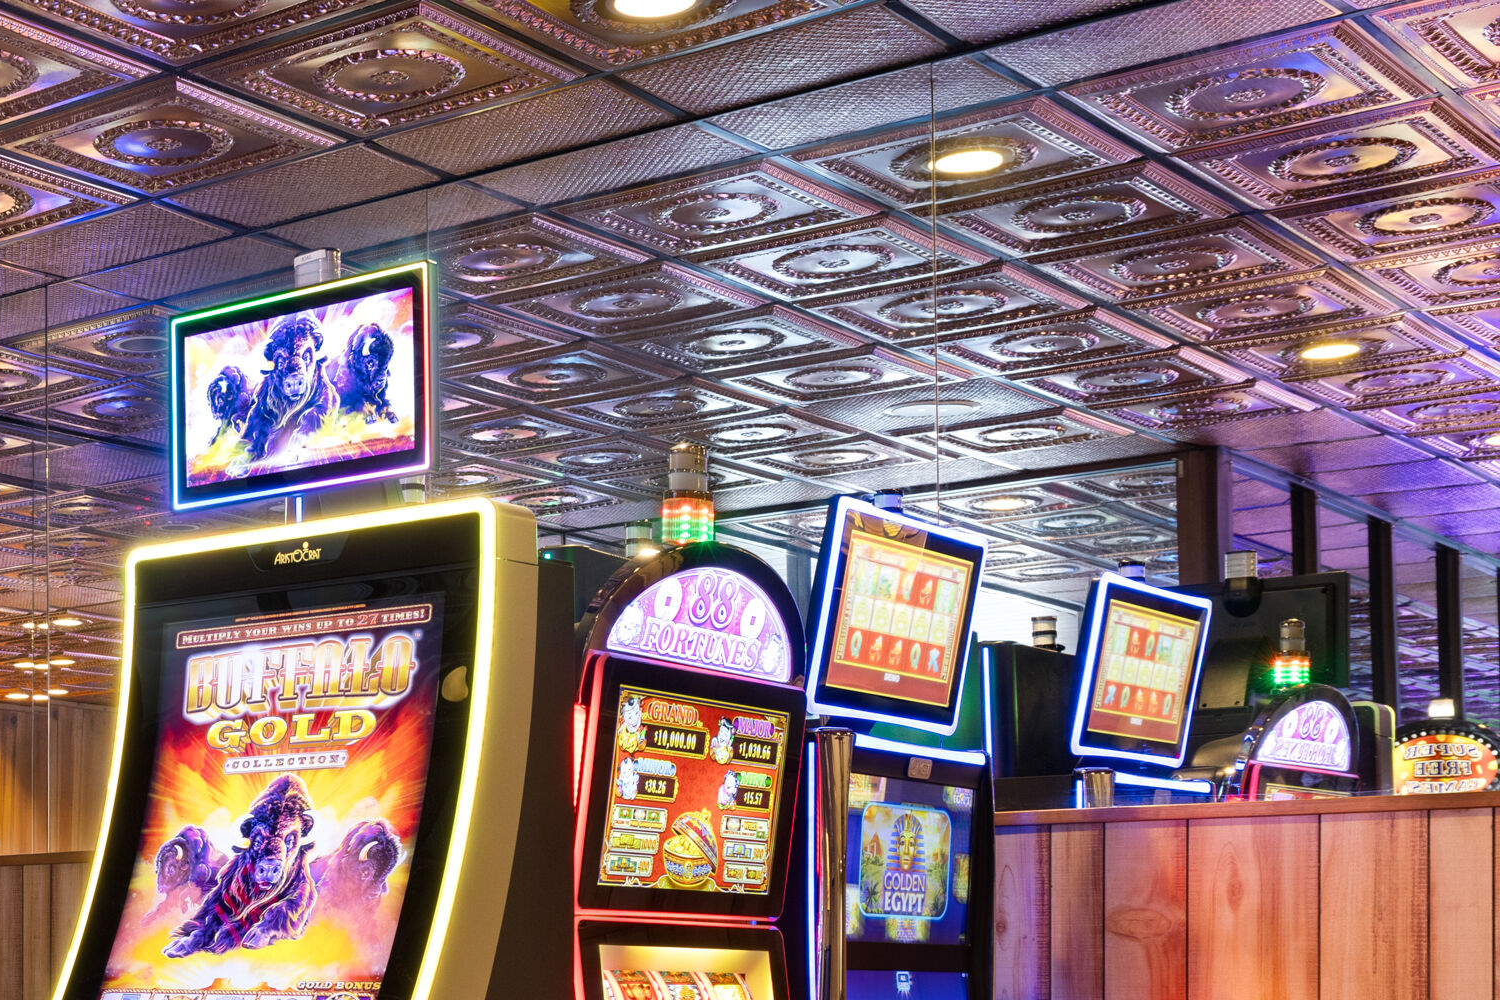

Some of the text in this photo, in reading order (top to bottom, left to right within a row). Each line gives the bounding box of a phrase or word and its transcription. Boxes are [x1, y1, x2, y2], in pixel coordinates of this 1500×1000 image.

[274, 541, 322, 565] ARISTOCRAT
[689, 569, 739, 629] 88
[245, 627, 277, 638] YOUR
[282, 622, 312, 633] WINS
[316, 620, 333, 631] UP
[337, 618, 355, 628] TO
[356, 613, 380, 627] 27
[381, 608, 426, 623] TIMES!
[640, 616, 761, 671] FORTUNES
[186, 635, 415, 714] BUFFALO
[651, 702, 696, 726] GRAND
[206, 709, 377, 752] GOLD
[738, 717, 771, 738] MAJOR
[654, 728, 697, 750] $10,000.00
[231, 755, 340, 769] COLLECTION
[638, 758, 672, 776] MINOR
[644, 779, 667, 795] $38.26
[740, 772, 766, 787] MINI
[743, 792, 763, 806] $15.57
[884, 871, 926, 892] GOLDEN
[884, 891, 925, 913] EGYPT
[296, 980, 382, 991] GOLD BONUS
